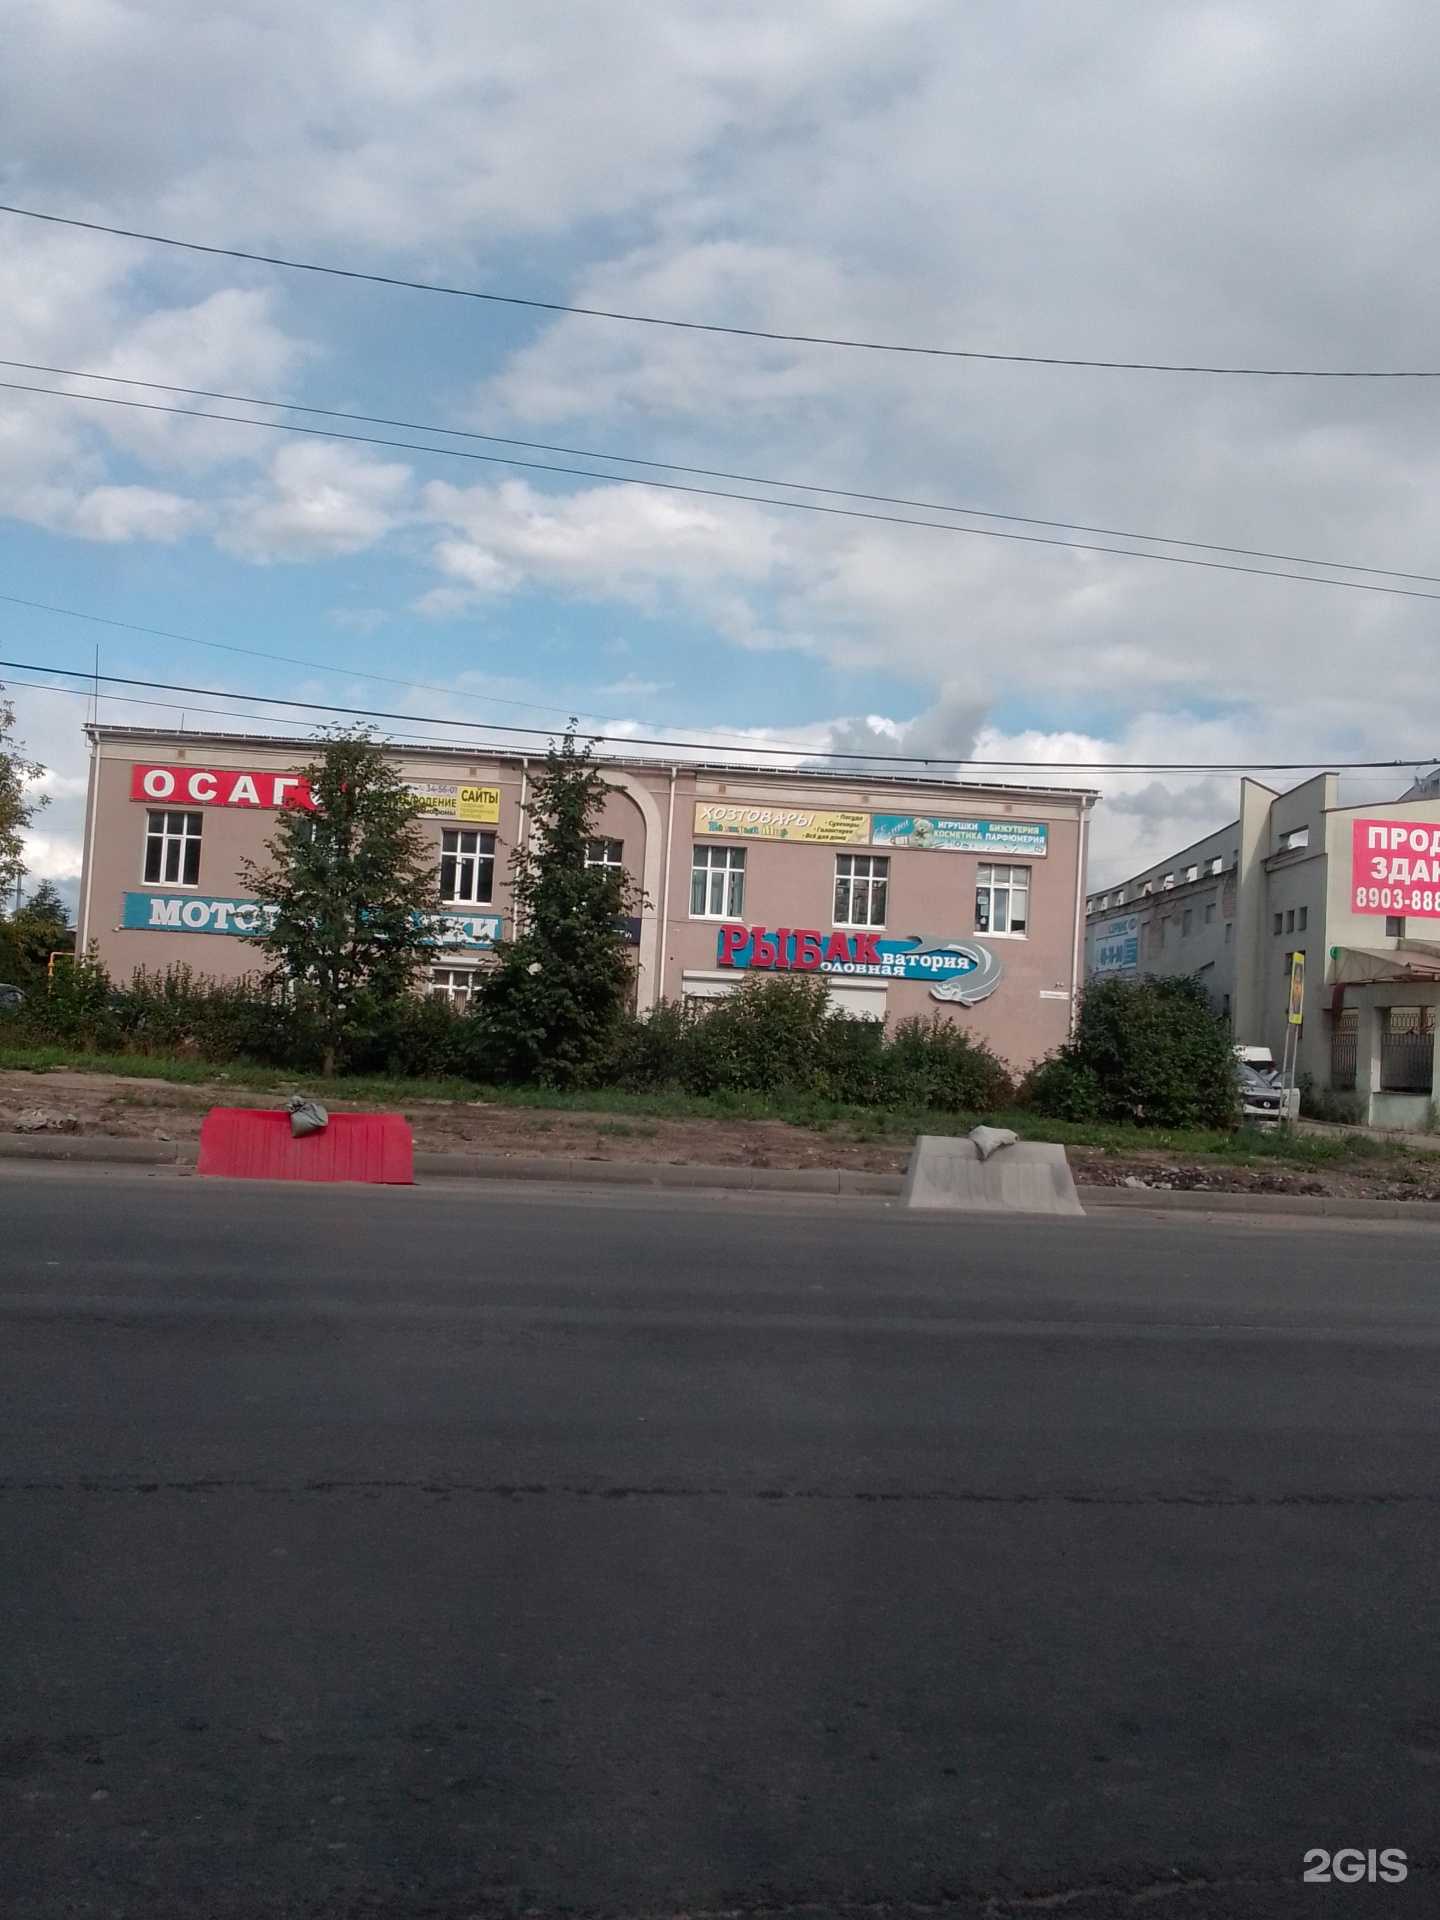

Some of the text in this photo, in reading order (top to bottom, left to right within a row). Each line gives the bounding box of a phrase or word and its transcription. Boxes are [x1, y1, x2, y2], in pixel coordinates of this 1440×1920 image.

[143, 769, 322, 806] ОСАГ
[461, 787, 498, 804] САЙТЫ
[701, 807, 817, 827] ХОЗТОВАРЫ
[937, 821, 1040, 834] ИГРУШКИ БИЖУТЕРИЯ
[934, 831, 1045, 844] КОСМЕТИКА ПАРФЮМЕРИЯ
[718, 925, 881, 970] РЫБАК
[882, 953, 969, 972] ватория
